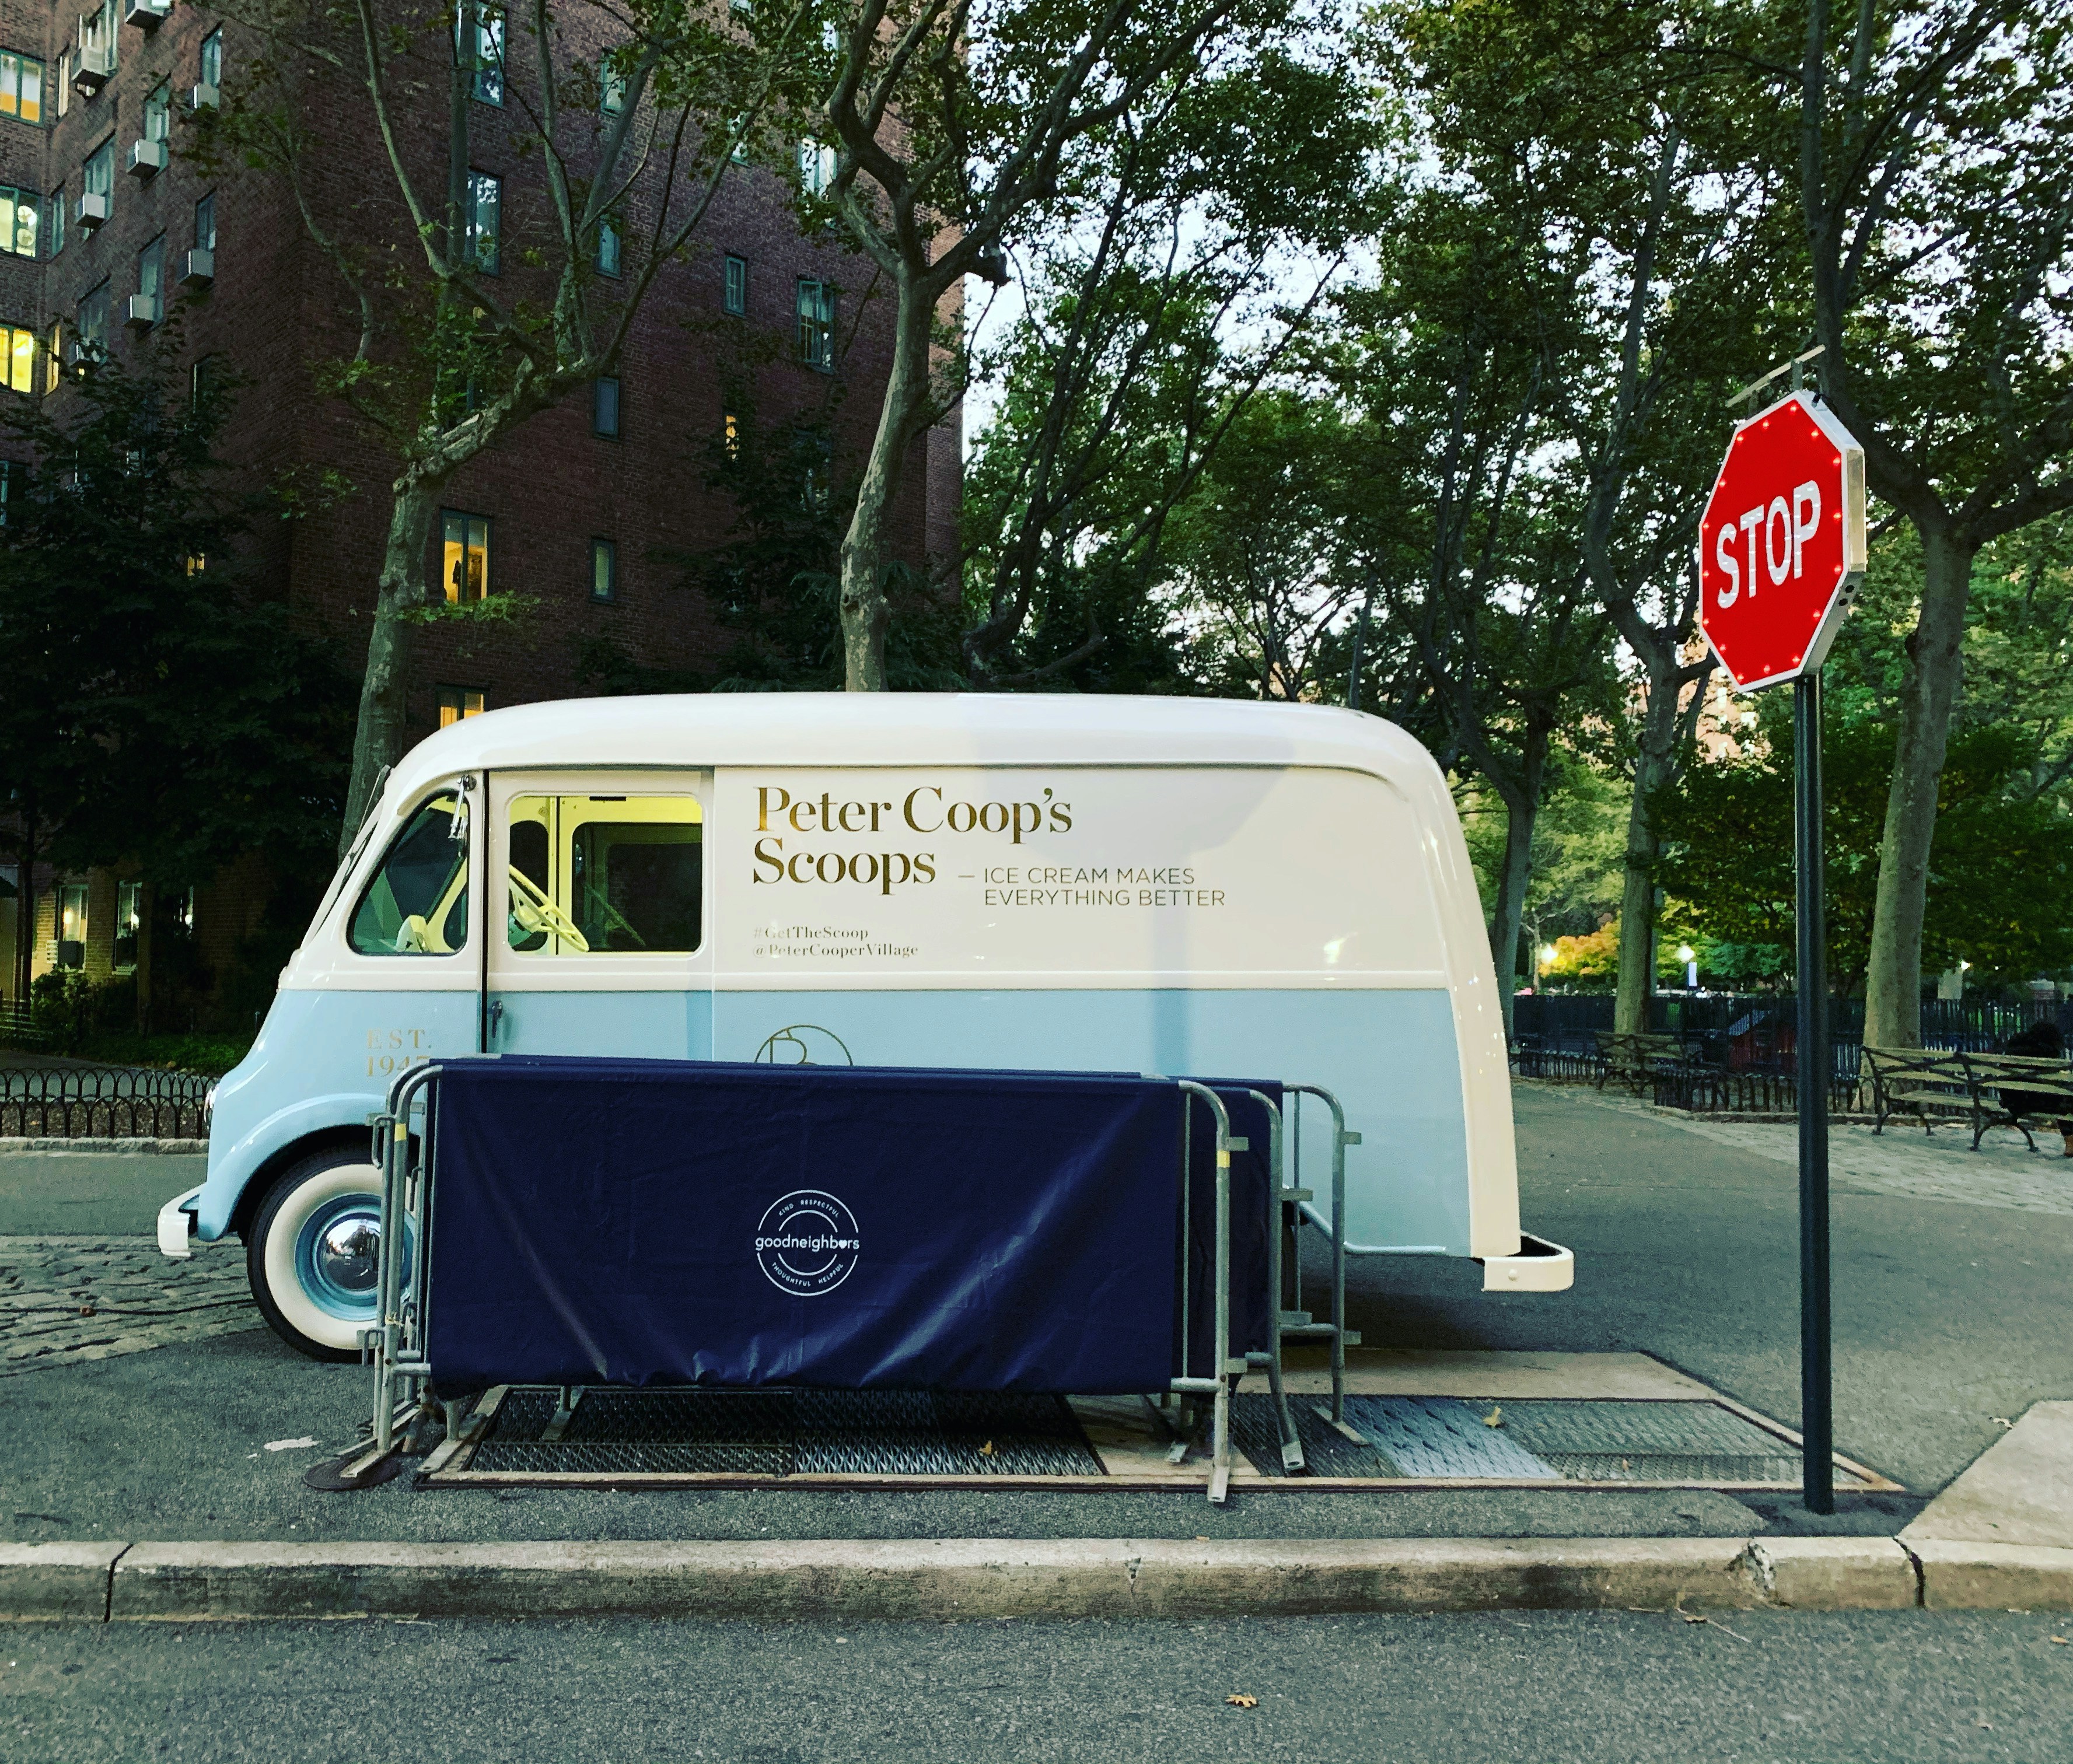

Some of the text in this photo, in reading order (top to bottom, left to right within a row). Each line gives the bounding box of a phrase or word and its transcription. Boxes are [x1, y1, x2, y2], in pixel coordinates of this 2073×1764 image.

[1717, 480, 1822, 609] STOP
[753, 786, 1072, 845] Peter Coop's
[753, 837, 936, 896] Scoops
[985, 867, 1195, 885] ICE CREAM MAKES
[985, 888, 1225, 907] EVERYTHING BETTER
[753, 926, 869, 942] #GetTheScoop
[753, 943, 918, 959] @PeterCooperVillage
[367, 1028, 432, 1049] EST.
[367, 1055, 431, 1077] 194
